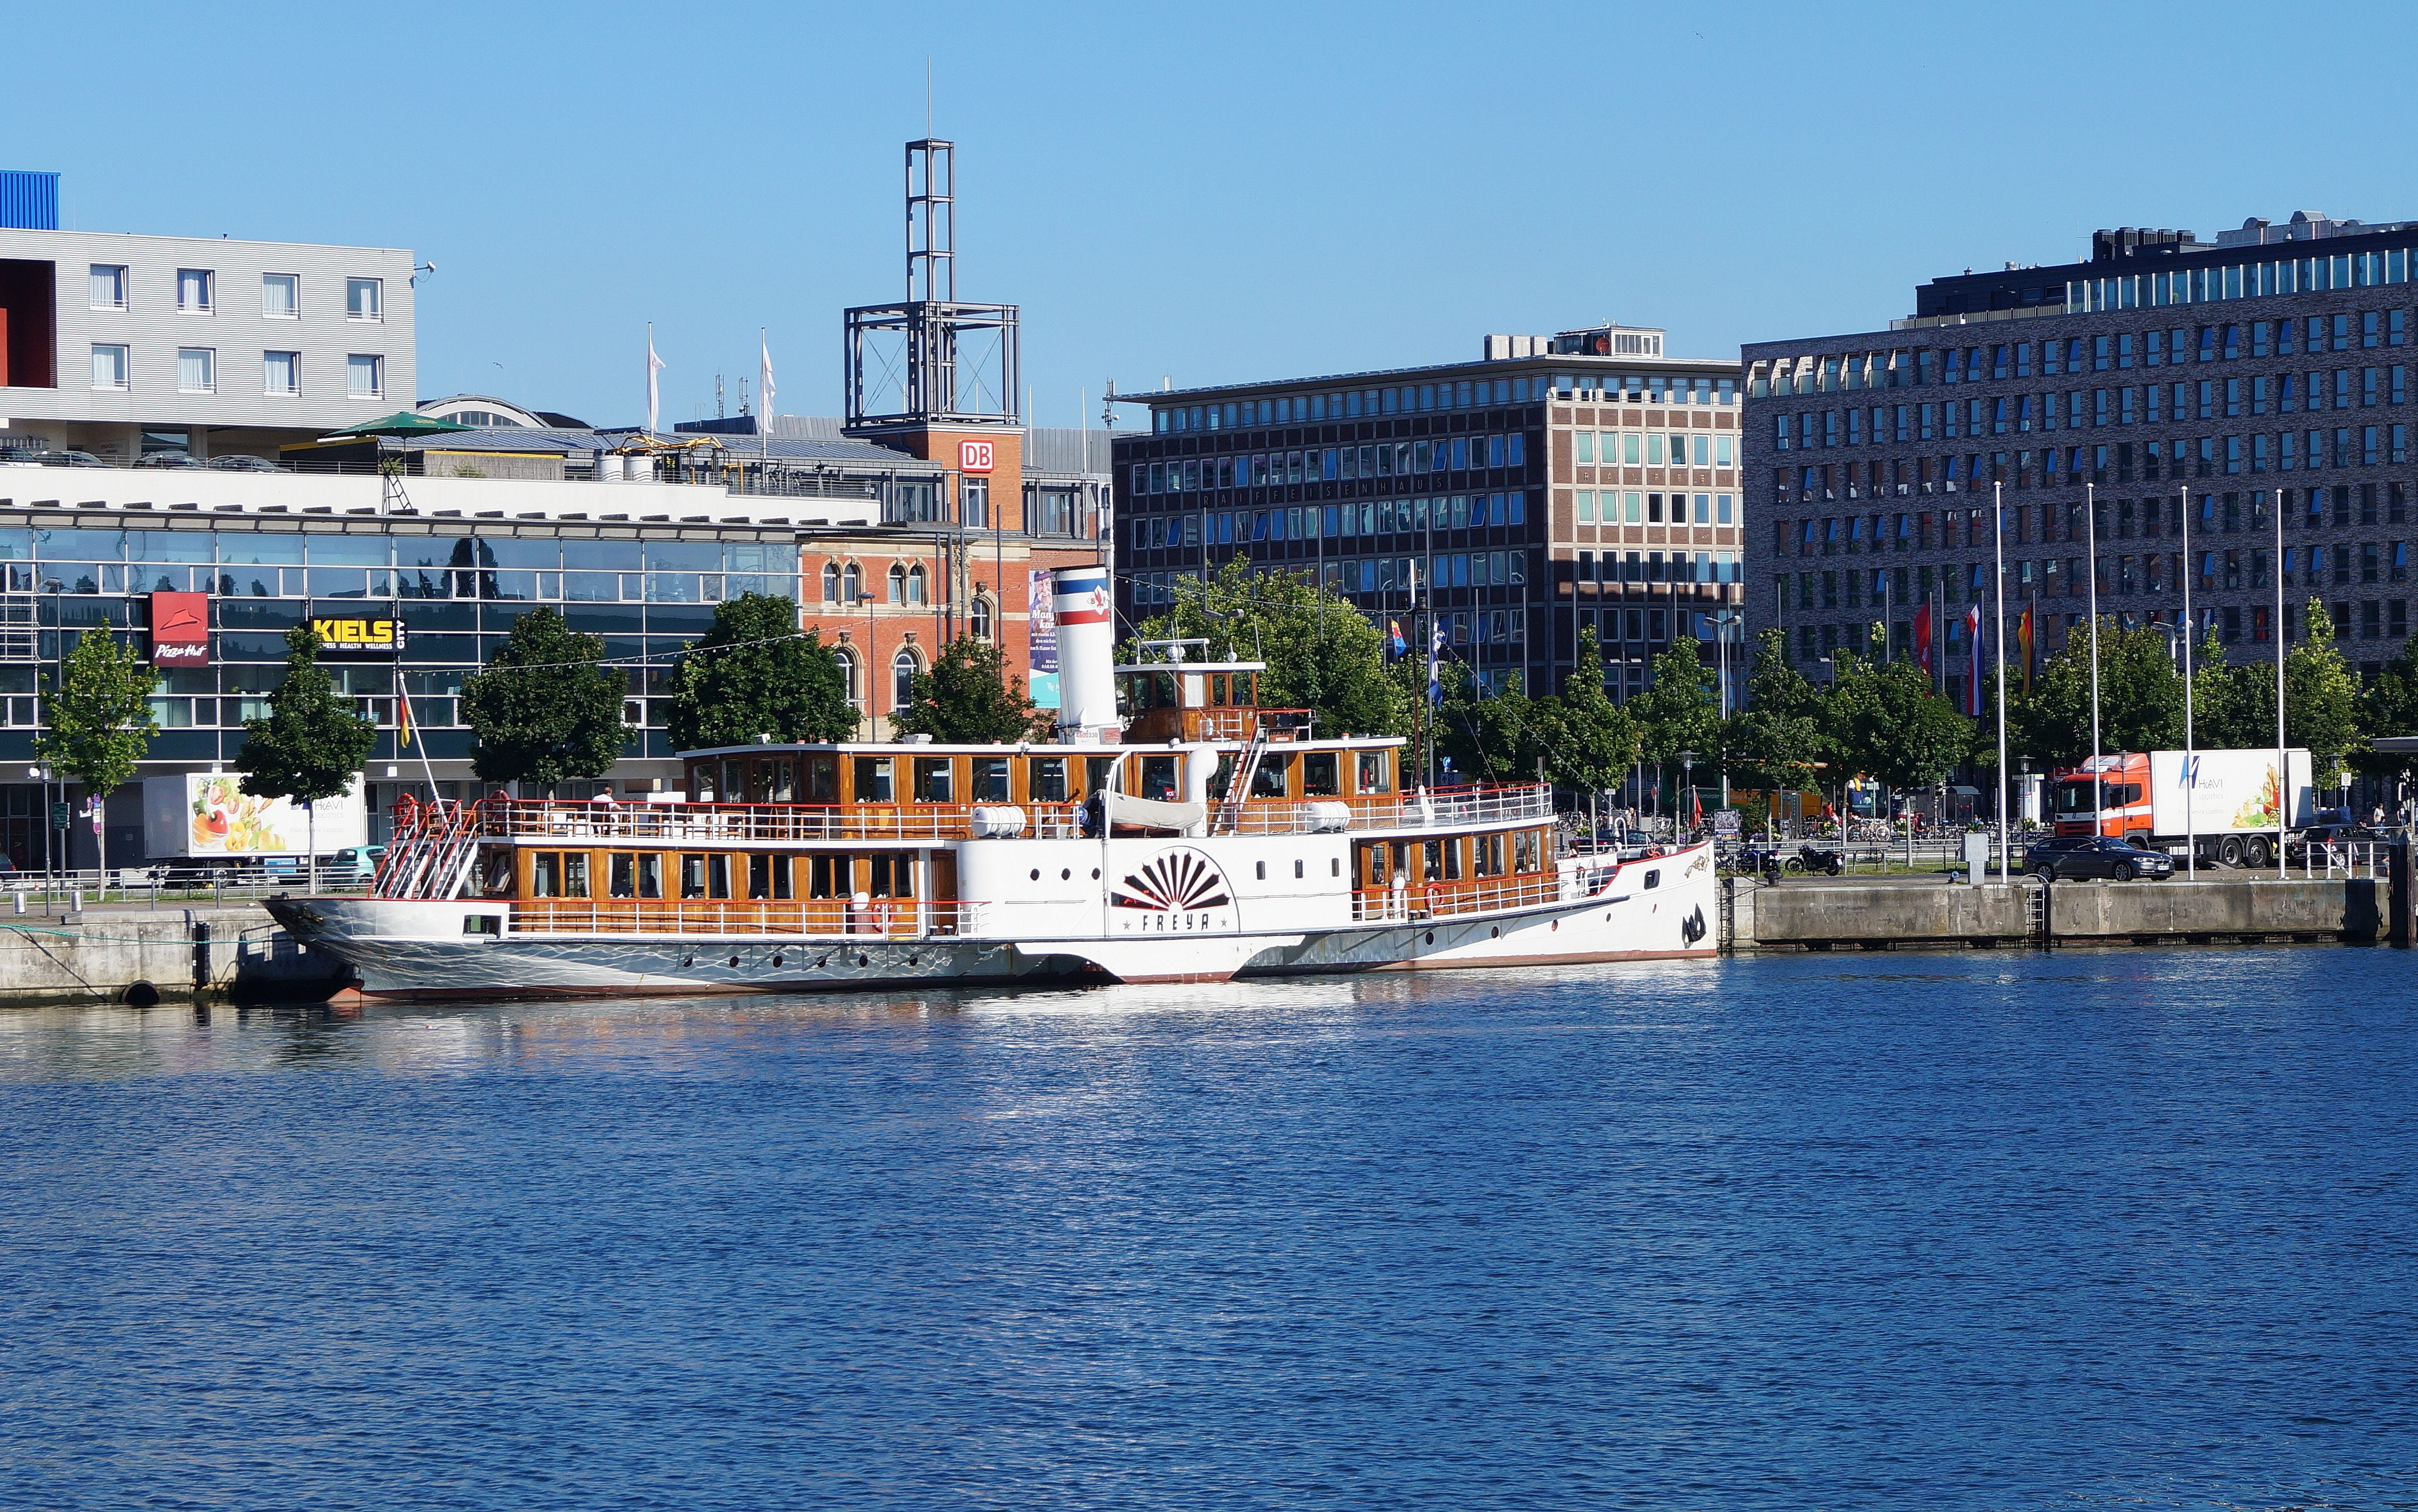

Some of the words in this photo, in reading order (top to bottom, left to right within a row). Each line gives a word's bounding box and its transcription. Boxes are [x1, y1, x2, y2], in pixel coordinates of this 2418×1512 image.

[965, 445, 990, 465] DB
[1204, 477, 1442, 505] RAIFFEISENHAUS
[314, 620, 393, 642] KIELS
[396, 619, 405, 649] CITY
[155, 644, 184, 658] Pizza
[184, 644, 207, 657] Hut
[1142, 913, 1209, 933] FREYA
